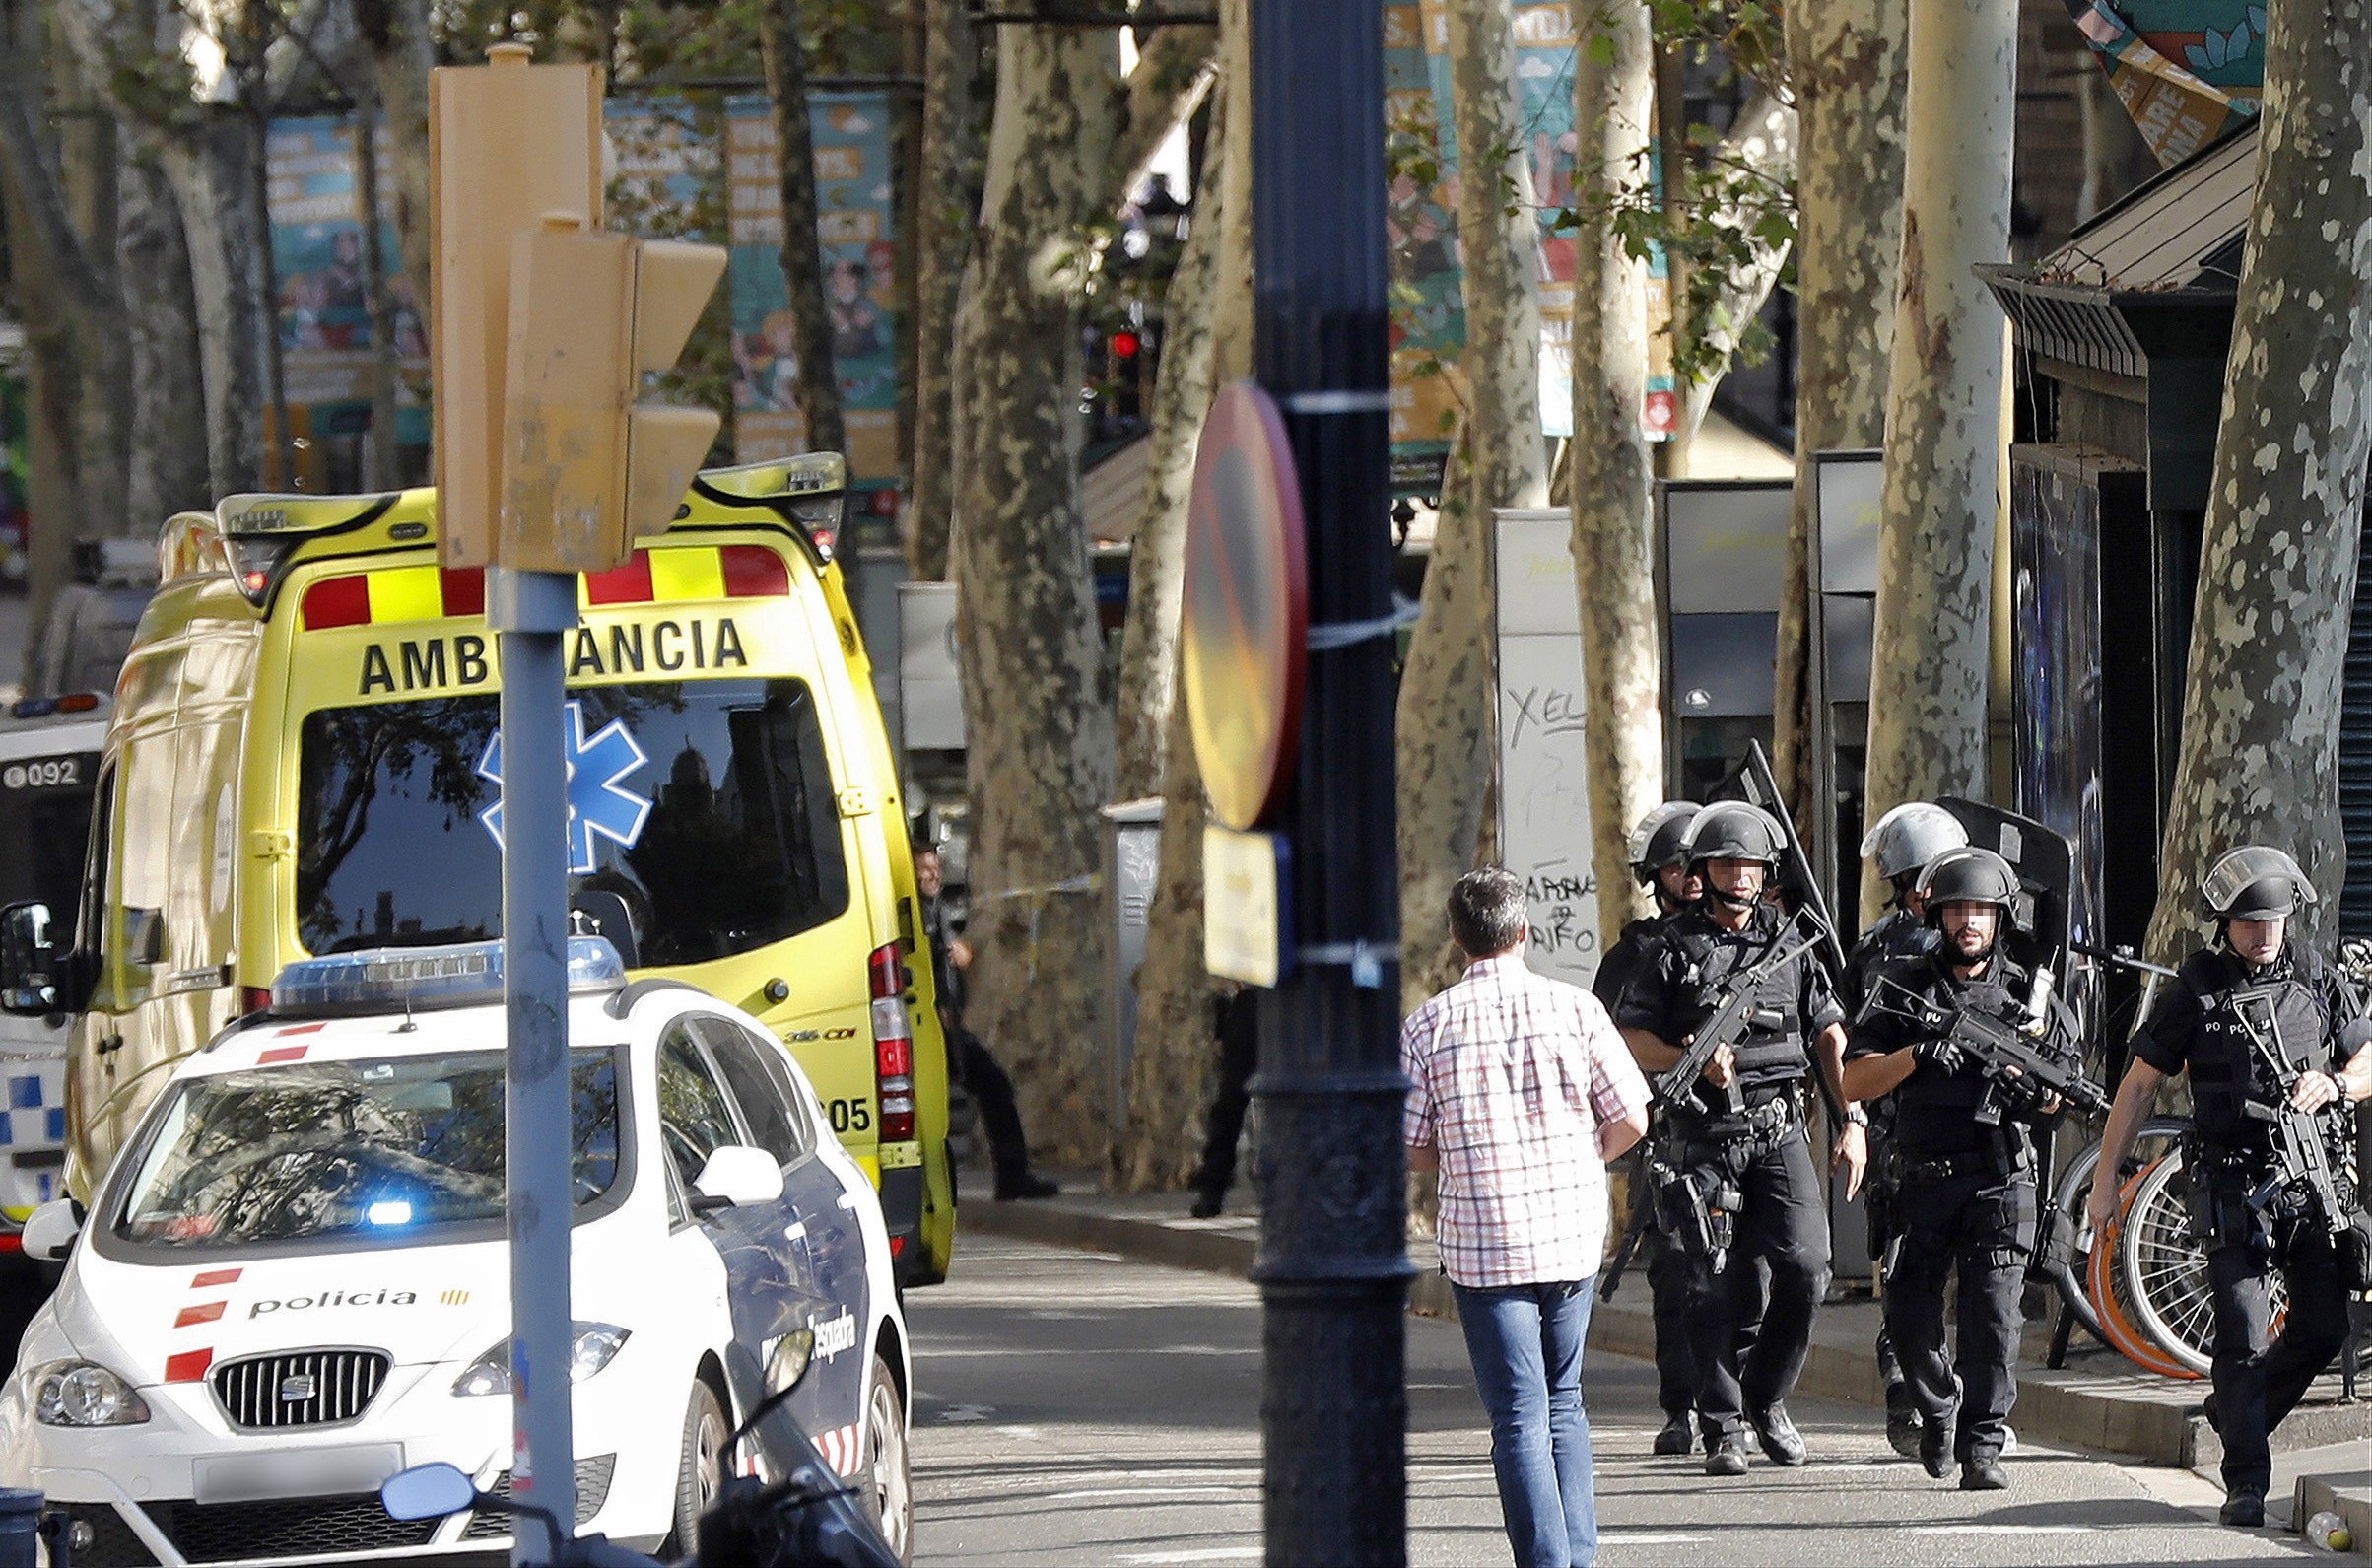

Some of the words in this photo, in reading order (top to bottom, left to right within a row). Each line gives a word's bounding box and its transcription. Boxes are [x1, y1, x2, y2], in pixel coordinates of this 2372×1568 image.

[358, 616, 748, 696] AMBÀNCIA
[28, 758, 78, 787] 092
[820, 1097, 871, 1133] 05
[247, 1288, 418, 1321] policia
